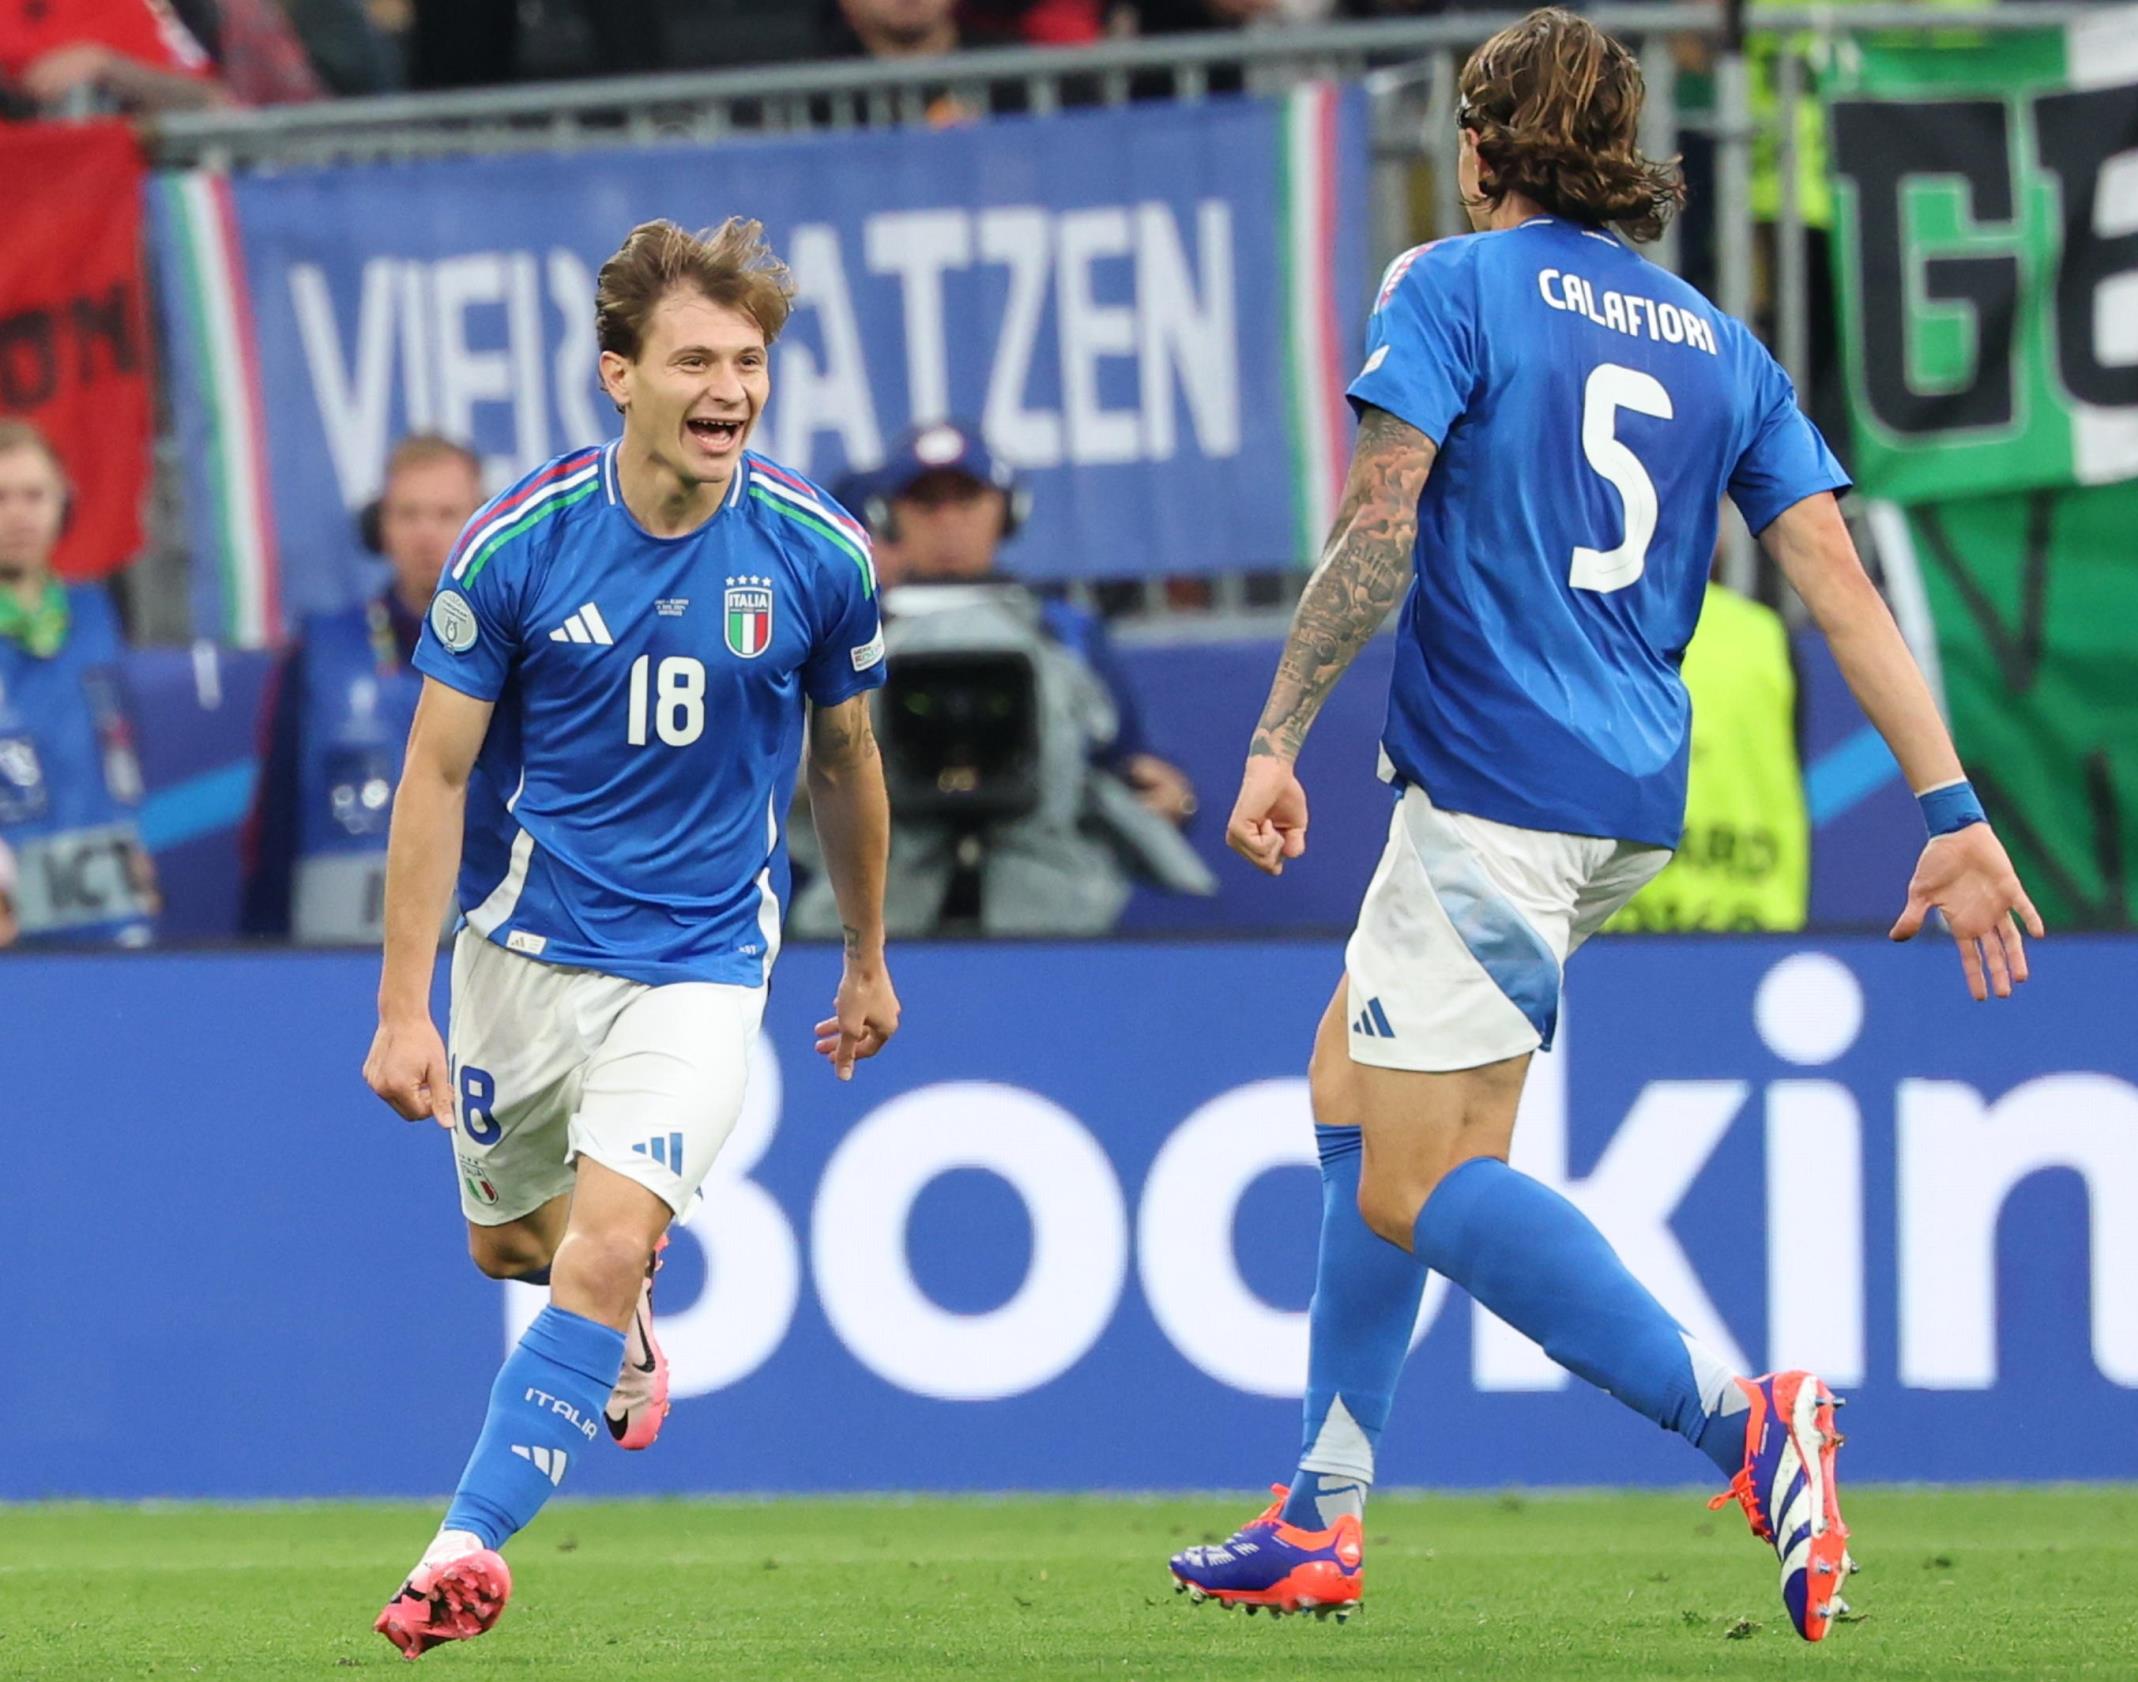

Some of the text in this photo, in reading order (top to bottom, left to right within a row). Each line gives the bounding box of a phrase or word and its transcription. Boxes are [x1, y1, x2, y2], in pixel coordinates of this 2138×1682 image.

[750, 200, 1241, 474] ATZEN
[1539, 268, 1717, 356] CALAFIORI
[1569, 363, 1673, 593] 5
[729, 593, 768, 608] ITALIA
[628, 655, 706, 747] 18
[525, 1388, 597, 1440] ITALIA
